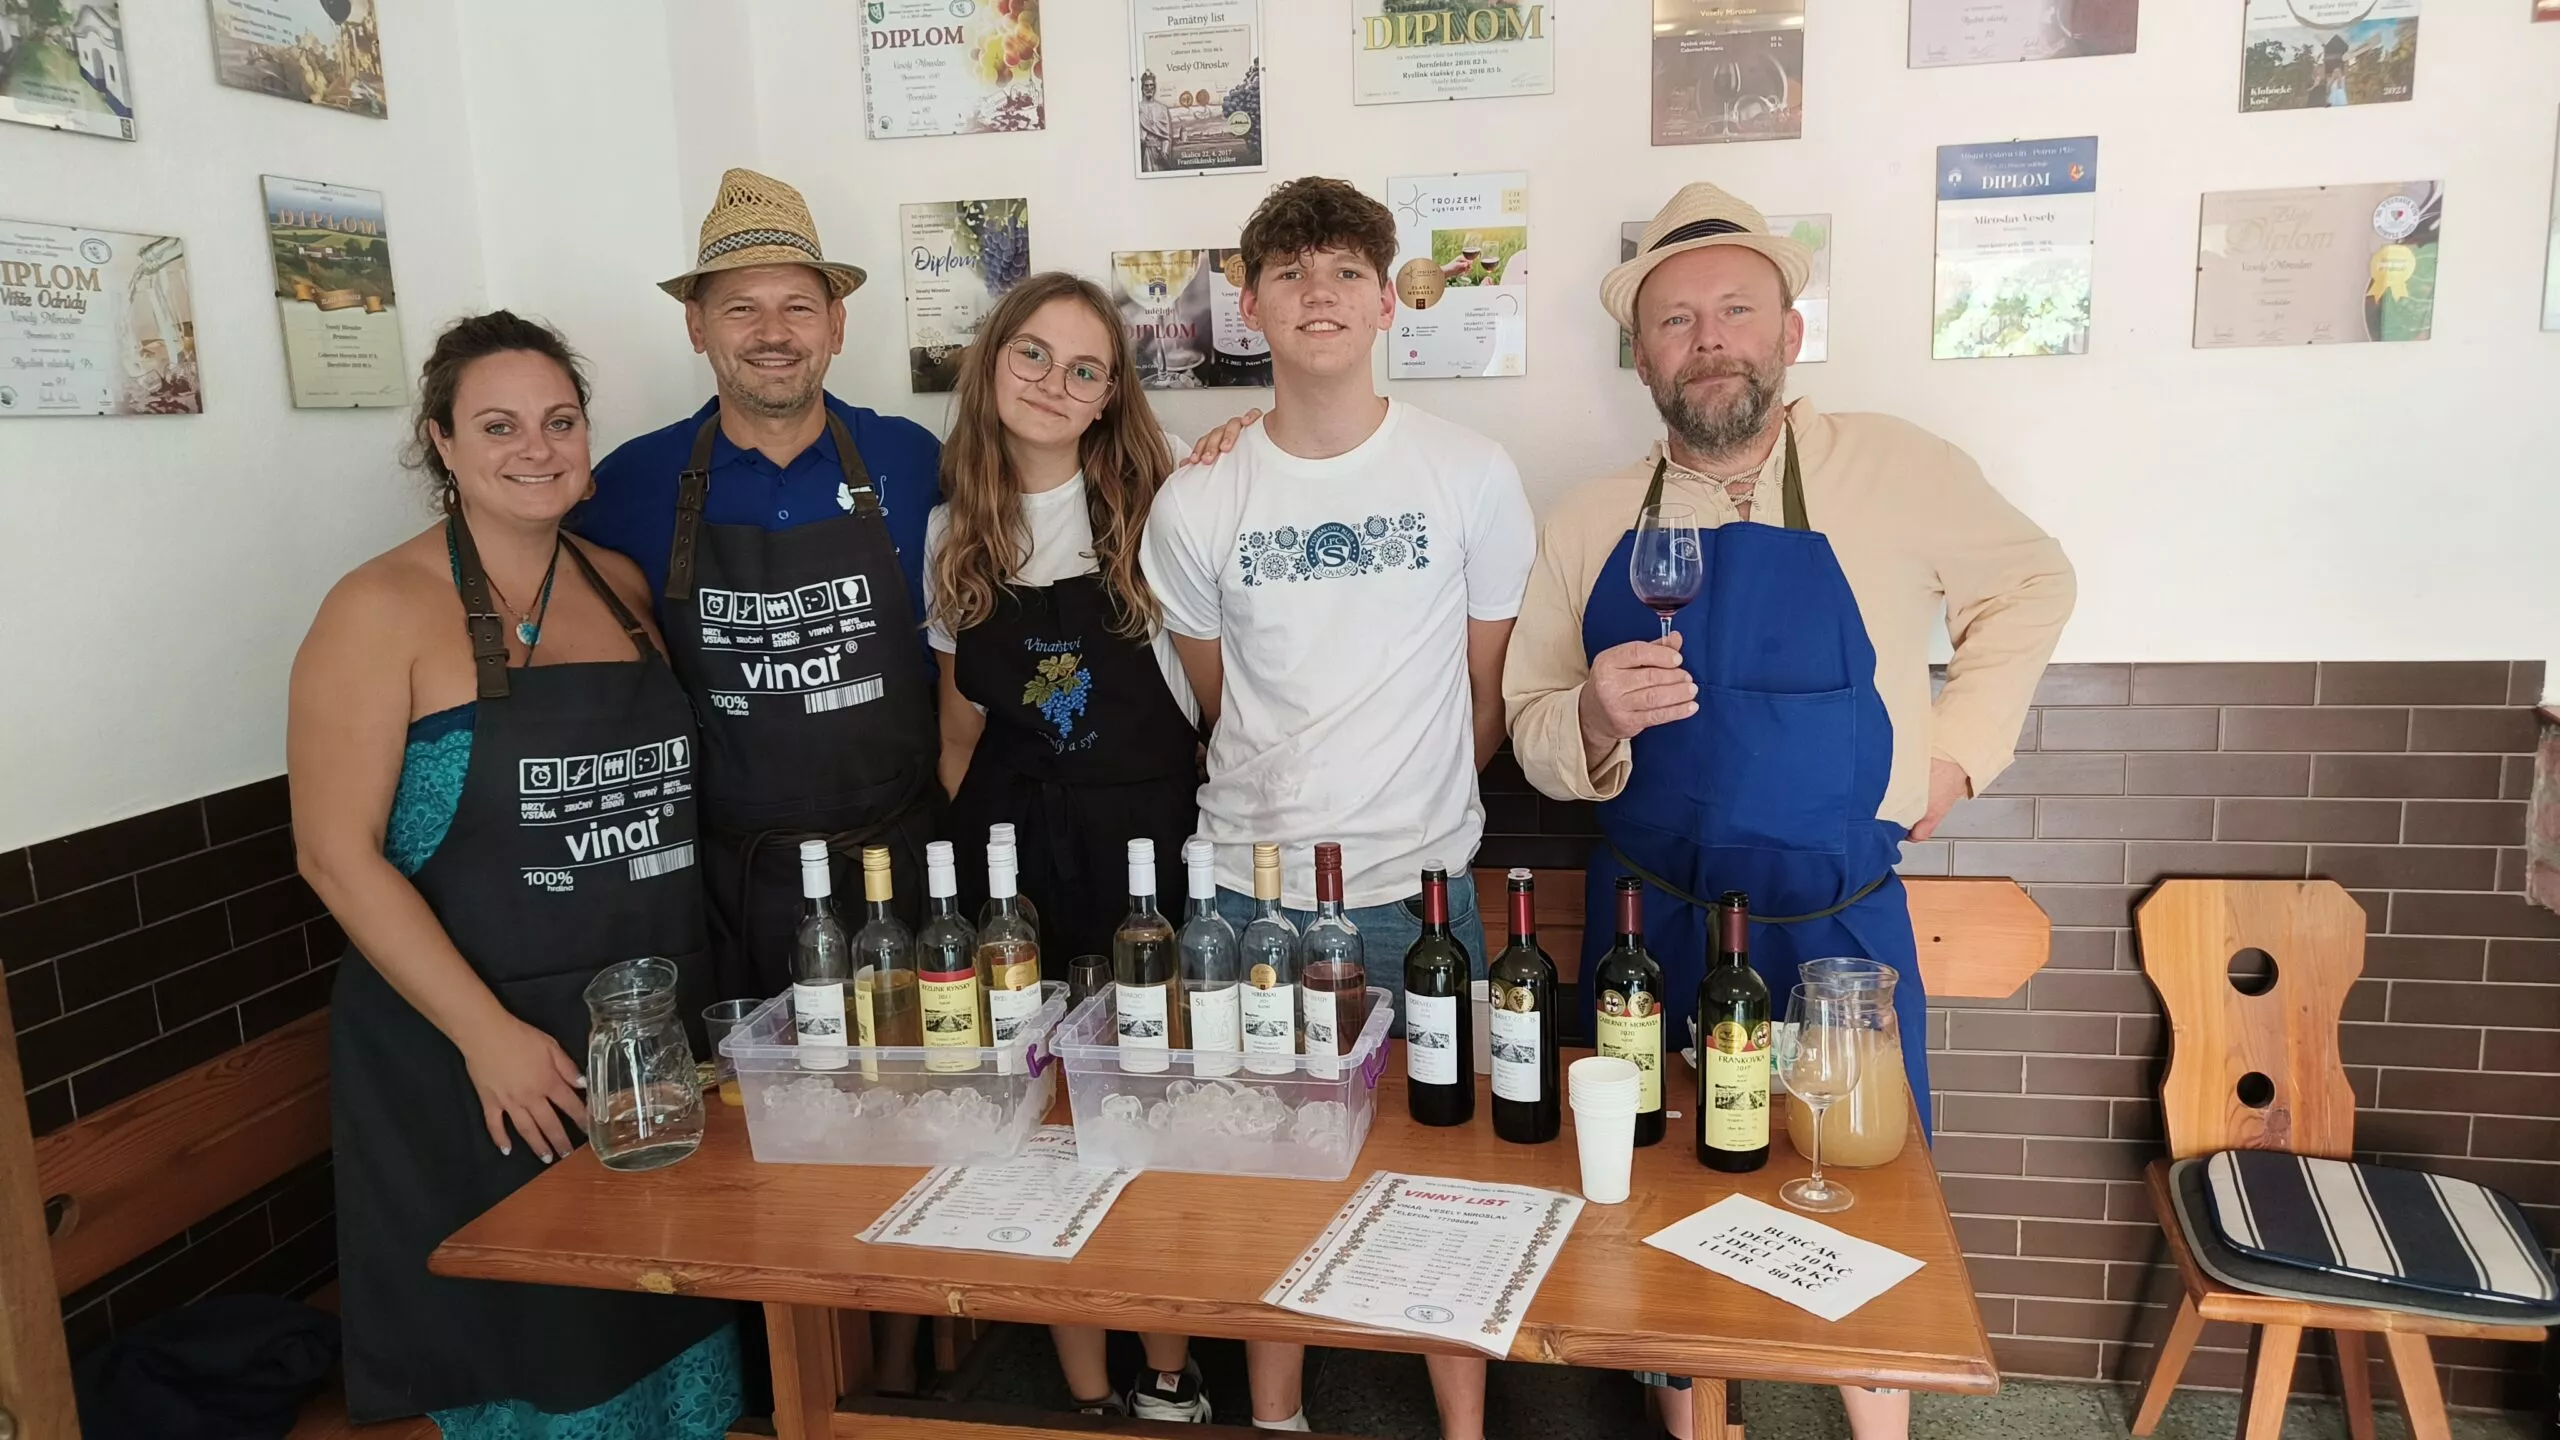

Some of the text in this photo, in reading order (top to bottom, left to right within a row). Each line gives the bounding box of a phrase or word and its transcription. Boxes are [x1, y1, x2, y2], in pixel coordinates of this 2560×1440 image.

[1211, 12, 1225, 22] list
[1363, 5, 1545, 50] DIPLOM
[871, 25, 965, 49] DIPLOM
[1416, 60, 1453, 69] Dornfelder
[1981, 172, 2051, 190] DIPLOM
[1431, 195, 1482, 205] TROJZEMÍ
[278, 207, 379, 236] DIPLOM
[1974, 213, 2020, 225] Miroslav
[2224, 217, 2335, 259] Diplom
[911, 245, 977, 278] Diplom
[0, 260, 102, 292] IPLOM
[1401, 326, 1415, 338] 2.
[702, 627, 722, 636] BRZY
[1024, 635, 1082, 653] Vinařství
[740, 644, 842, 690] vinař
[711, 694, 749, 710] 100%
[1080, 730, 1099, 749] syn
[521, 802, 546, 812] BRZY
[521, 808, 558, 820] VSTÁVÁ
[564, 807, 661, 863] vinař
[522, 870, 574, 887] 100%
[546, 884, 574, 892] hrdina
[1599, 1015, 1627, 1027] CABERNET
[1718, 1055, 1765, 1065] FRANKOVKA
[1465, 1197, 1511, 1207] LIST
[1523, 1206, 1534, 1214] 7
[1462, 1211, 1509, 1220] MIROSLAV
[1763, 1226, 1843, 1261] BURČÁK
[1712, 1233, 1726, 1241] 2
[1726, 1237, 1772, 1259] DECI
[1785, 1261, 1808, 1273] 20
[1808, 1270, 1841, 1287] KČ
[1740, 1230, 1786, 1252] DECI
[1800, 1254, 1821, 1265] 10
[1822, 1262, 1855, 1279] KČ
[1698, 1240, 1709, 1248] 1
[1709, 1244, 1755, 1265] LITR
[1767, 1267, 1791, 1281] 80
[1791, 1277, 1824, 1294] KČ
